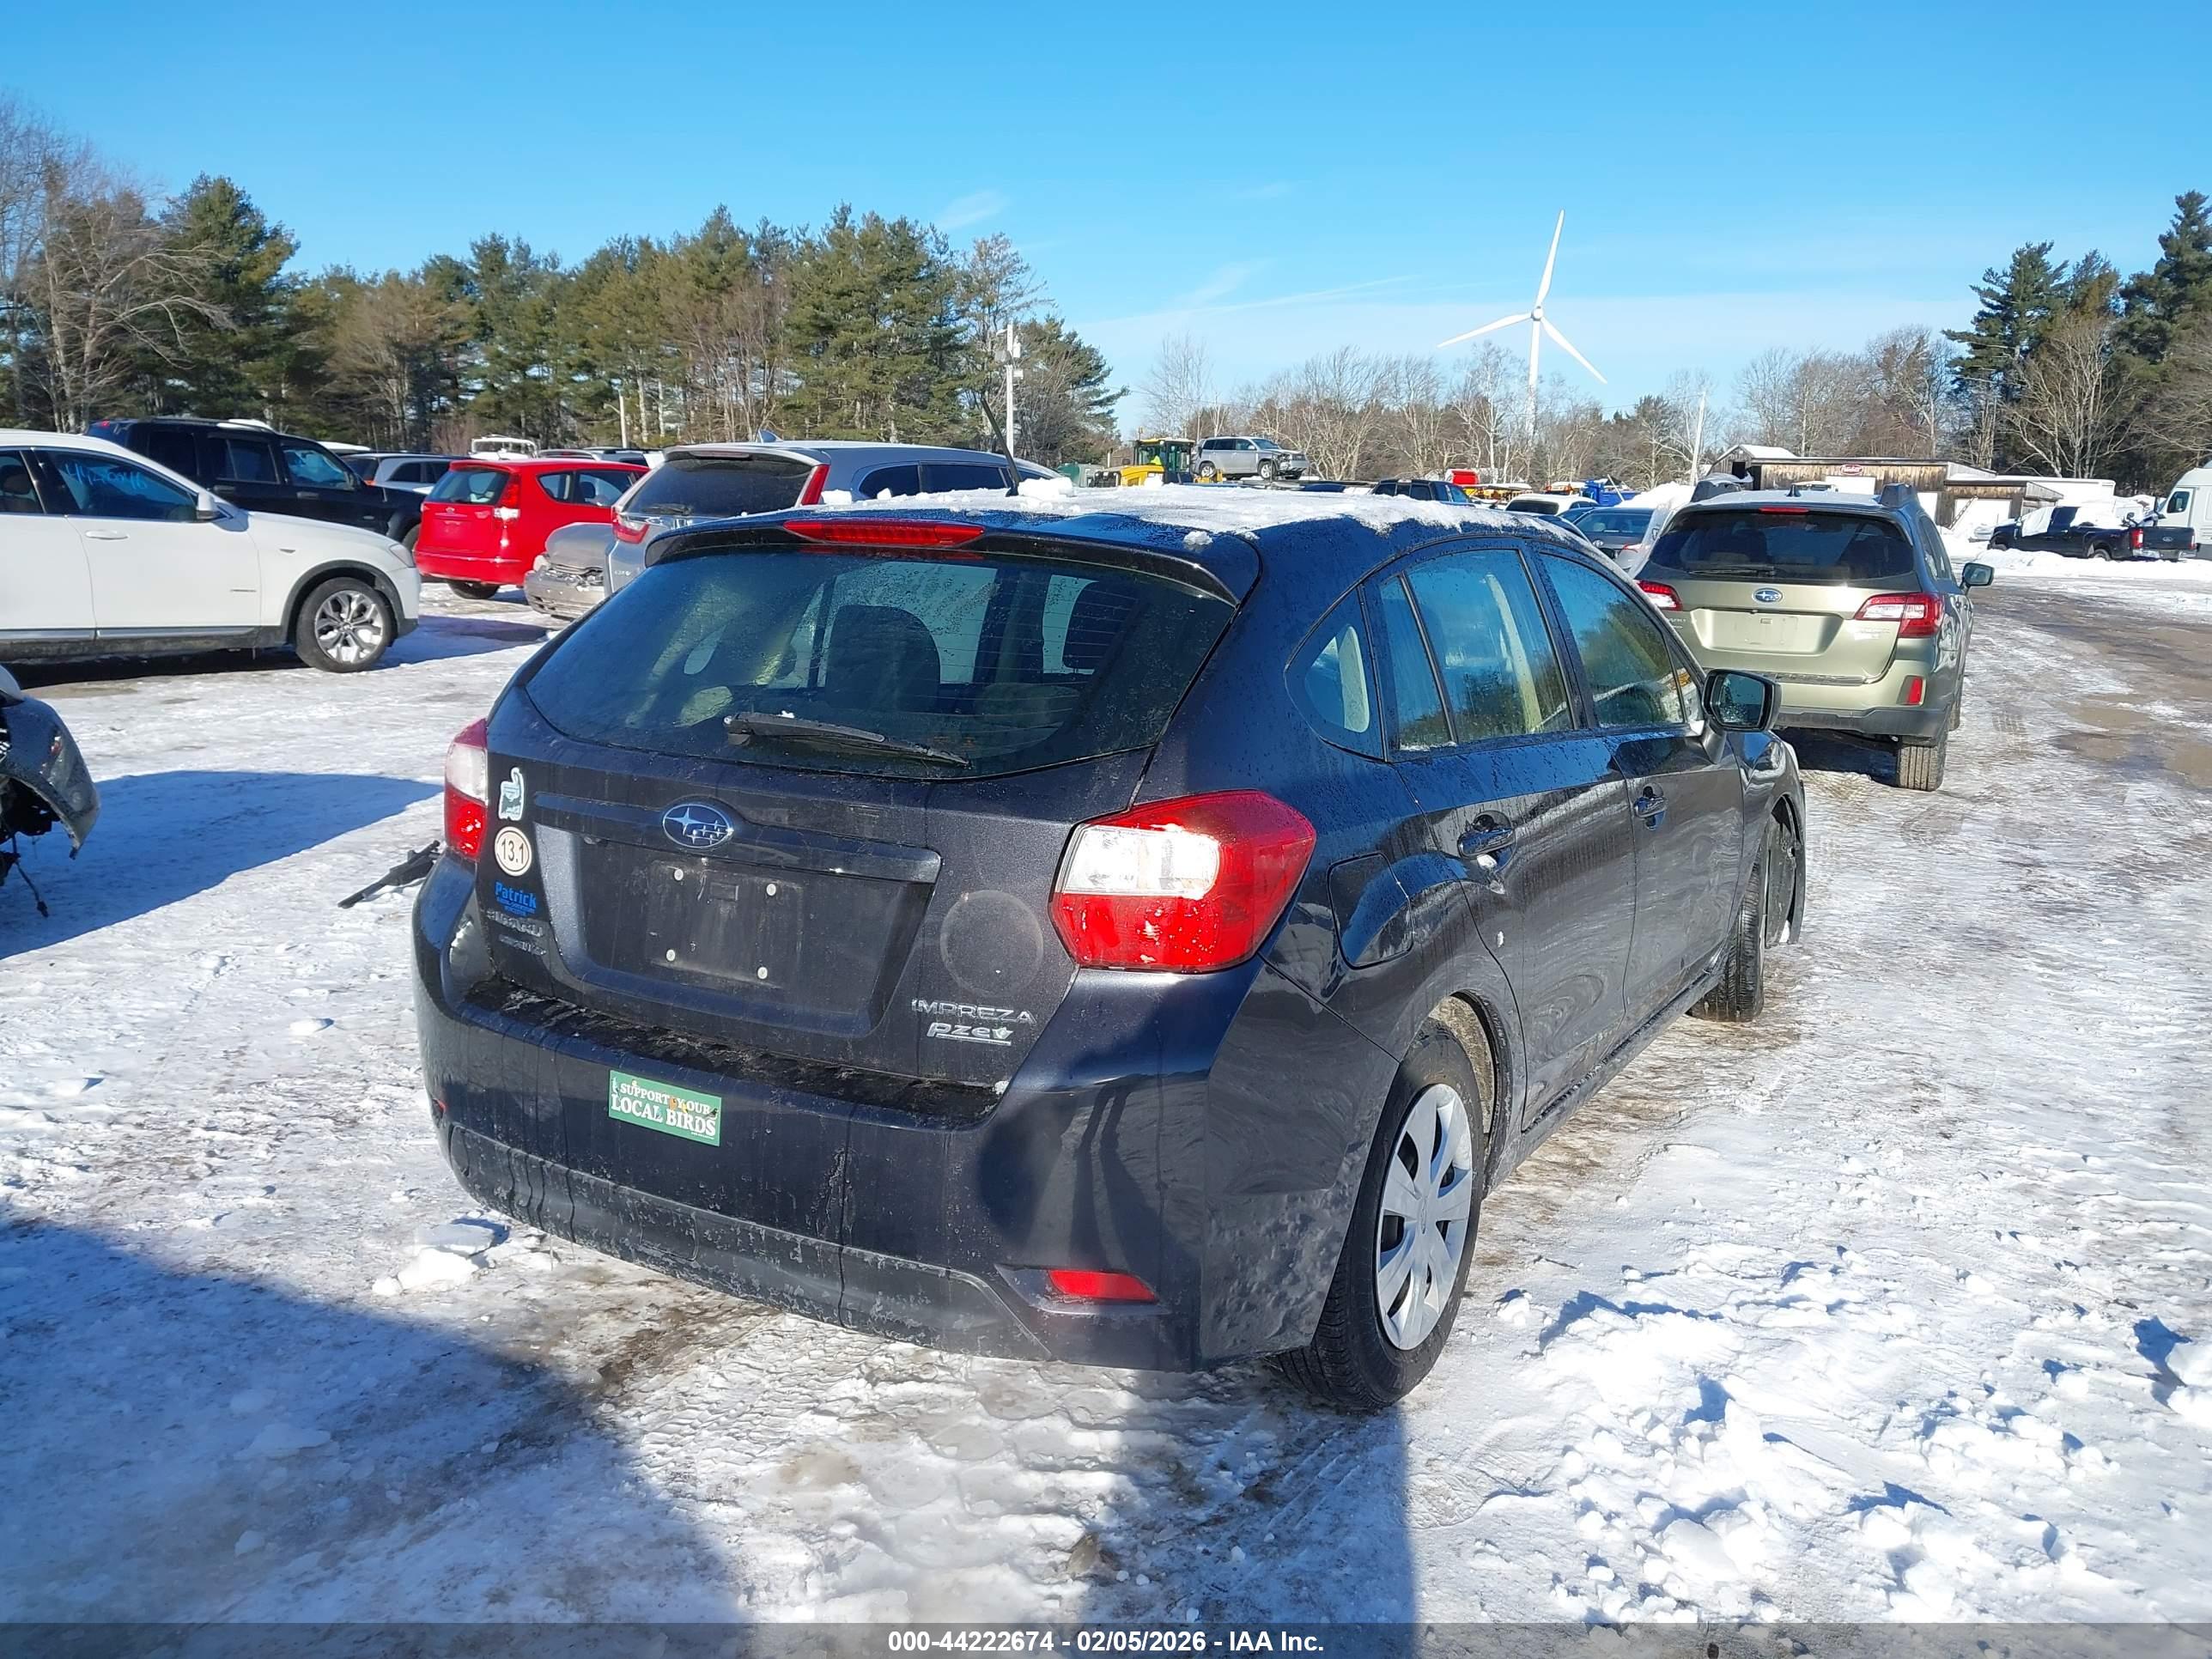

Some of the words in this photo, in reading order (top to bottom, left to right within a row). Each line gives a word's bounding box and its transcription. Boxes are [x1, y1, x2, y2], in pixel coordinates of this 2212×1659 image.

[501, 838, 525, 865] 13.1
[495, 881, 537, 908] Patrick
[912, 999, 1036, 1024] IMPREZA
[620, 1083, 670, 1104] SUPPORT
[677, 1098, 711, 1115] YOUR
[611, 1093, 663, 1123] LOCAL
[665, 1109, 716, 1136] BIRDS
